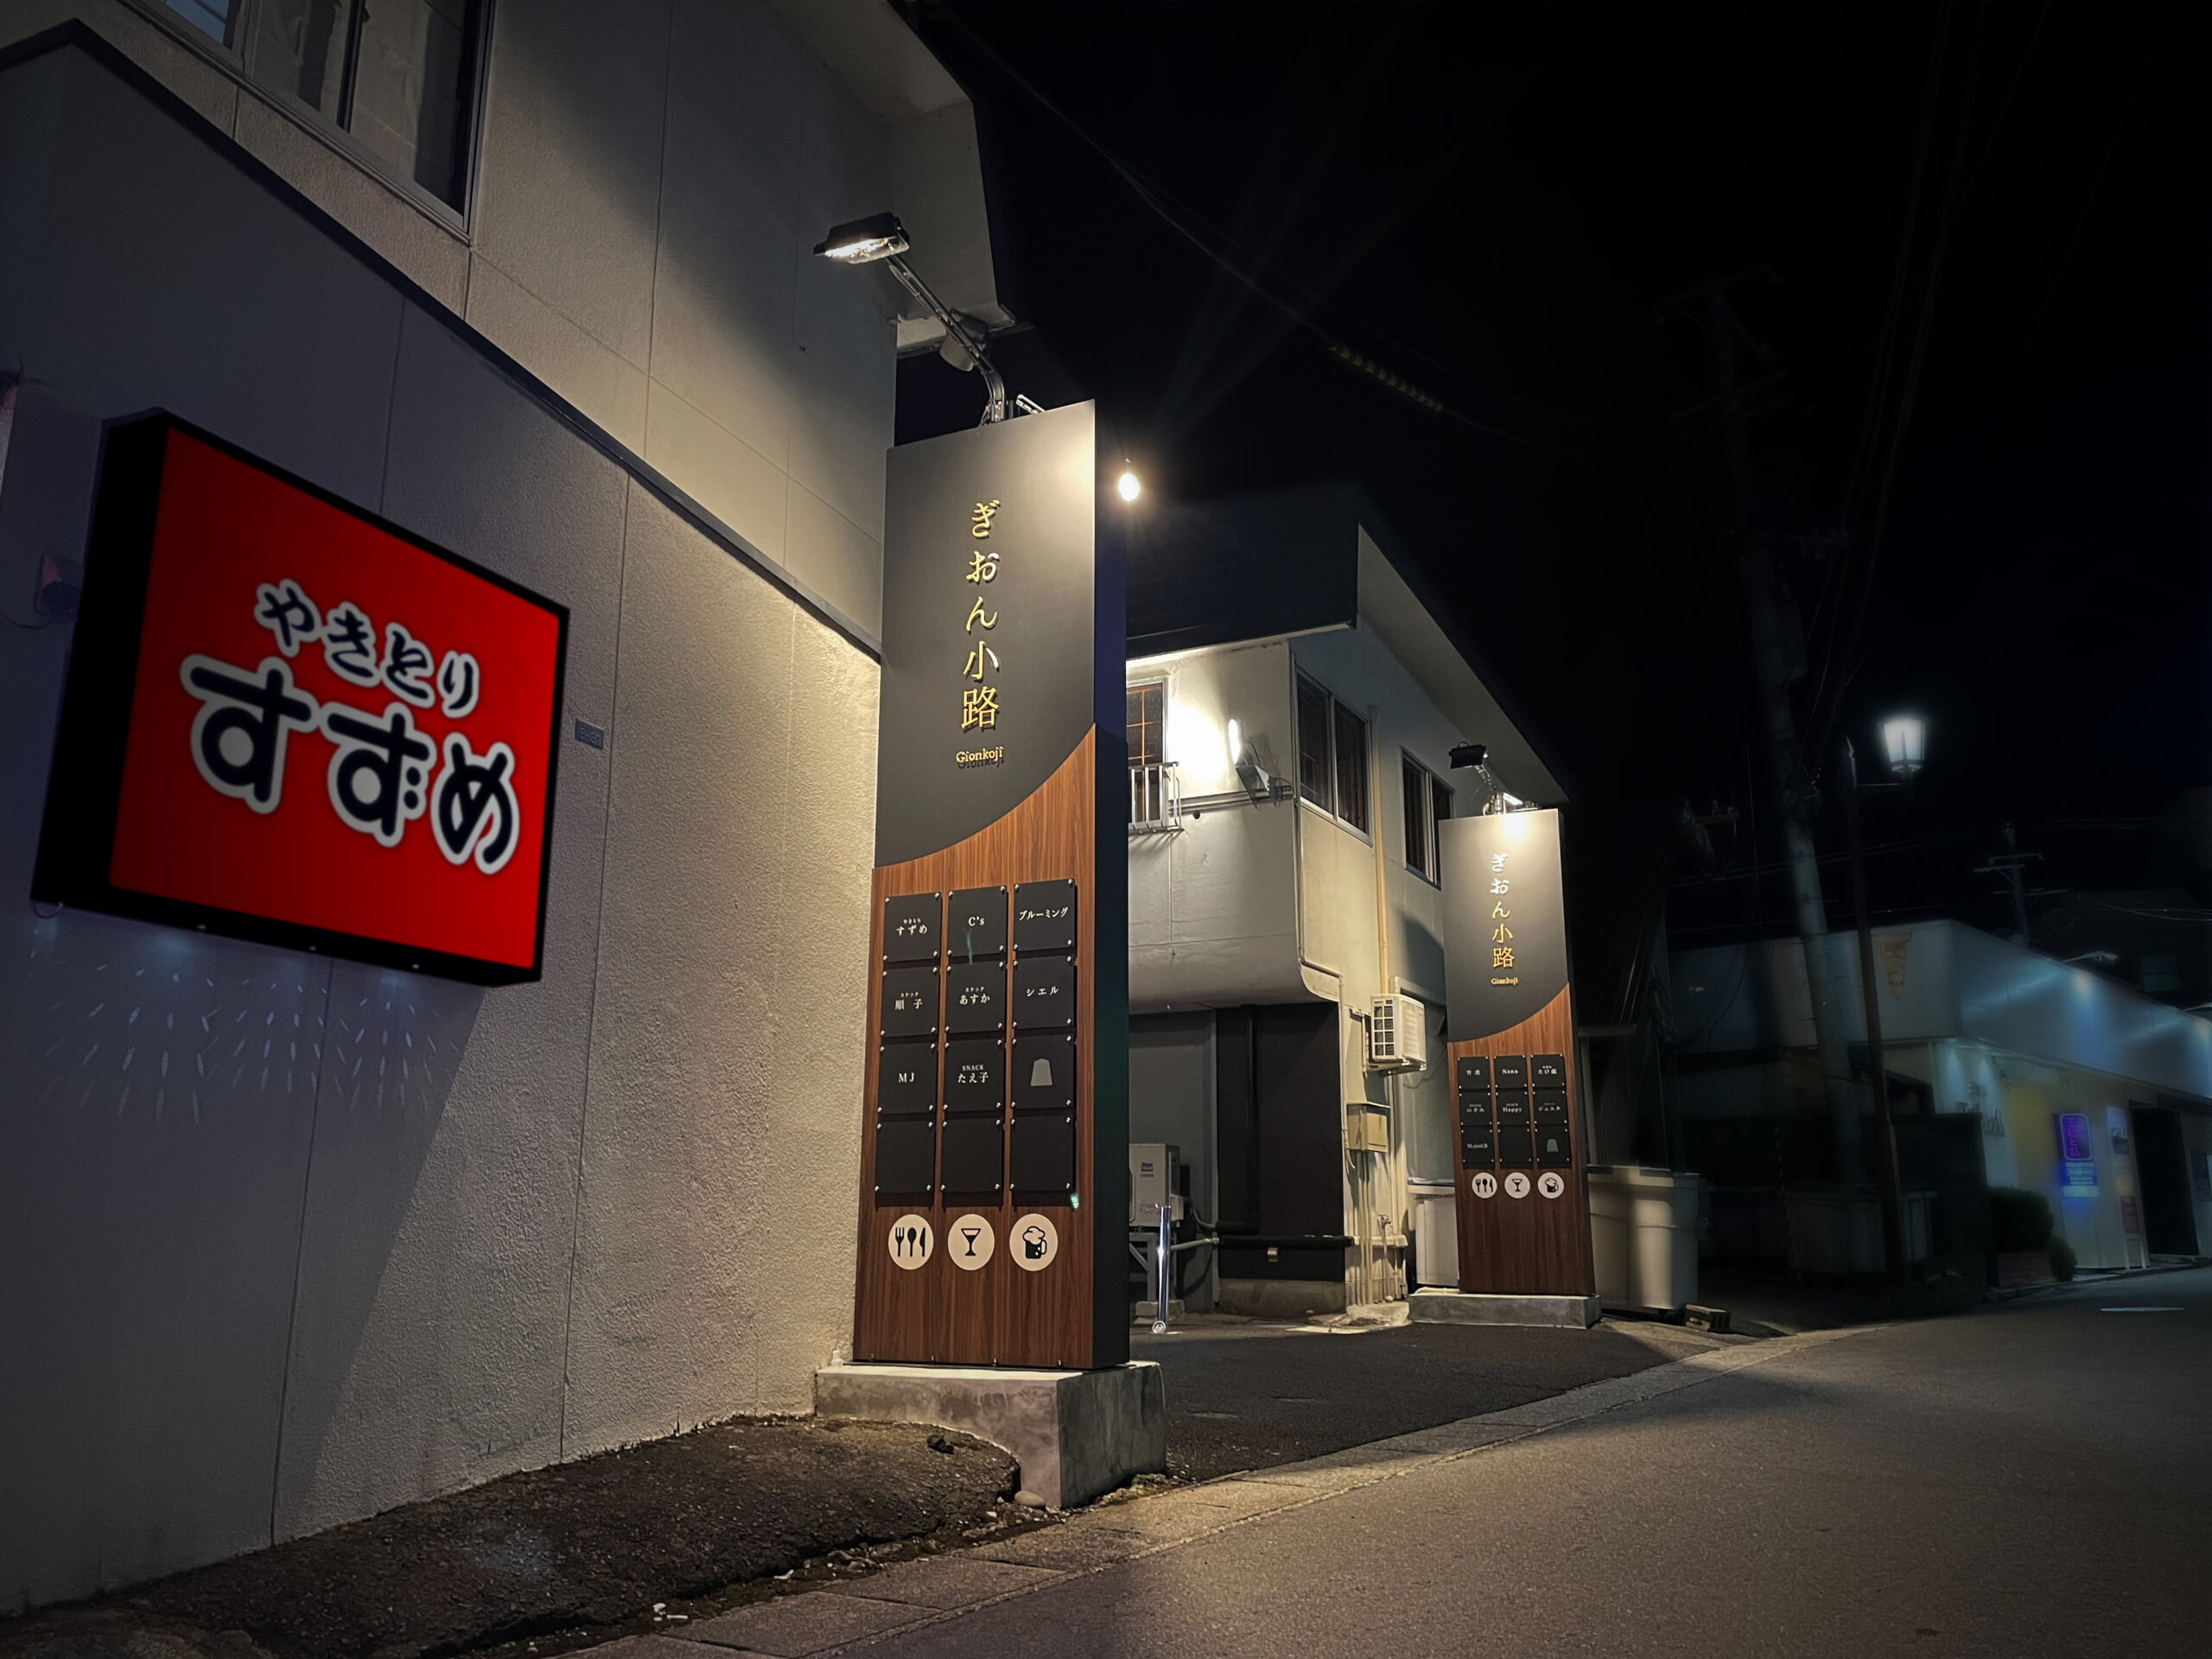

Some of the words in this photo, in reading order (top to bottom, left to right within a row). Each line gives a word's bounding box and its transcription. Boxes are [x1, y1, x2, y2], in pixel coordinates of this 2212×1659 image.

[961, 499, 1000, 729] ぎおん小路
[254, 578, 480, 719] やきとり
[956, 746, 1003, 762] Gionkoji
[180, 652, 519, 874] すずめ
[1019, 906, 1069, 921] ブルーミング
[1491, 853, 1515, 969] ぎおん小路
[968, 916, 985, 927] C's
[896, 925, 928, 937] すずめ
[1491, 976, 1518, 986] Gionkoji
[959, 994, 990, 1005] あすか
[957, 1071, 988, 1084] たえ子
